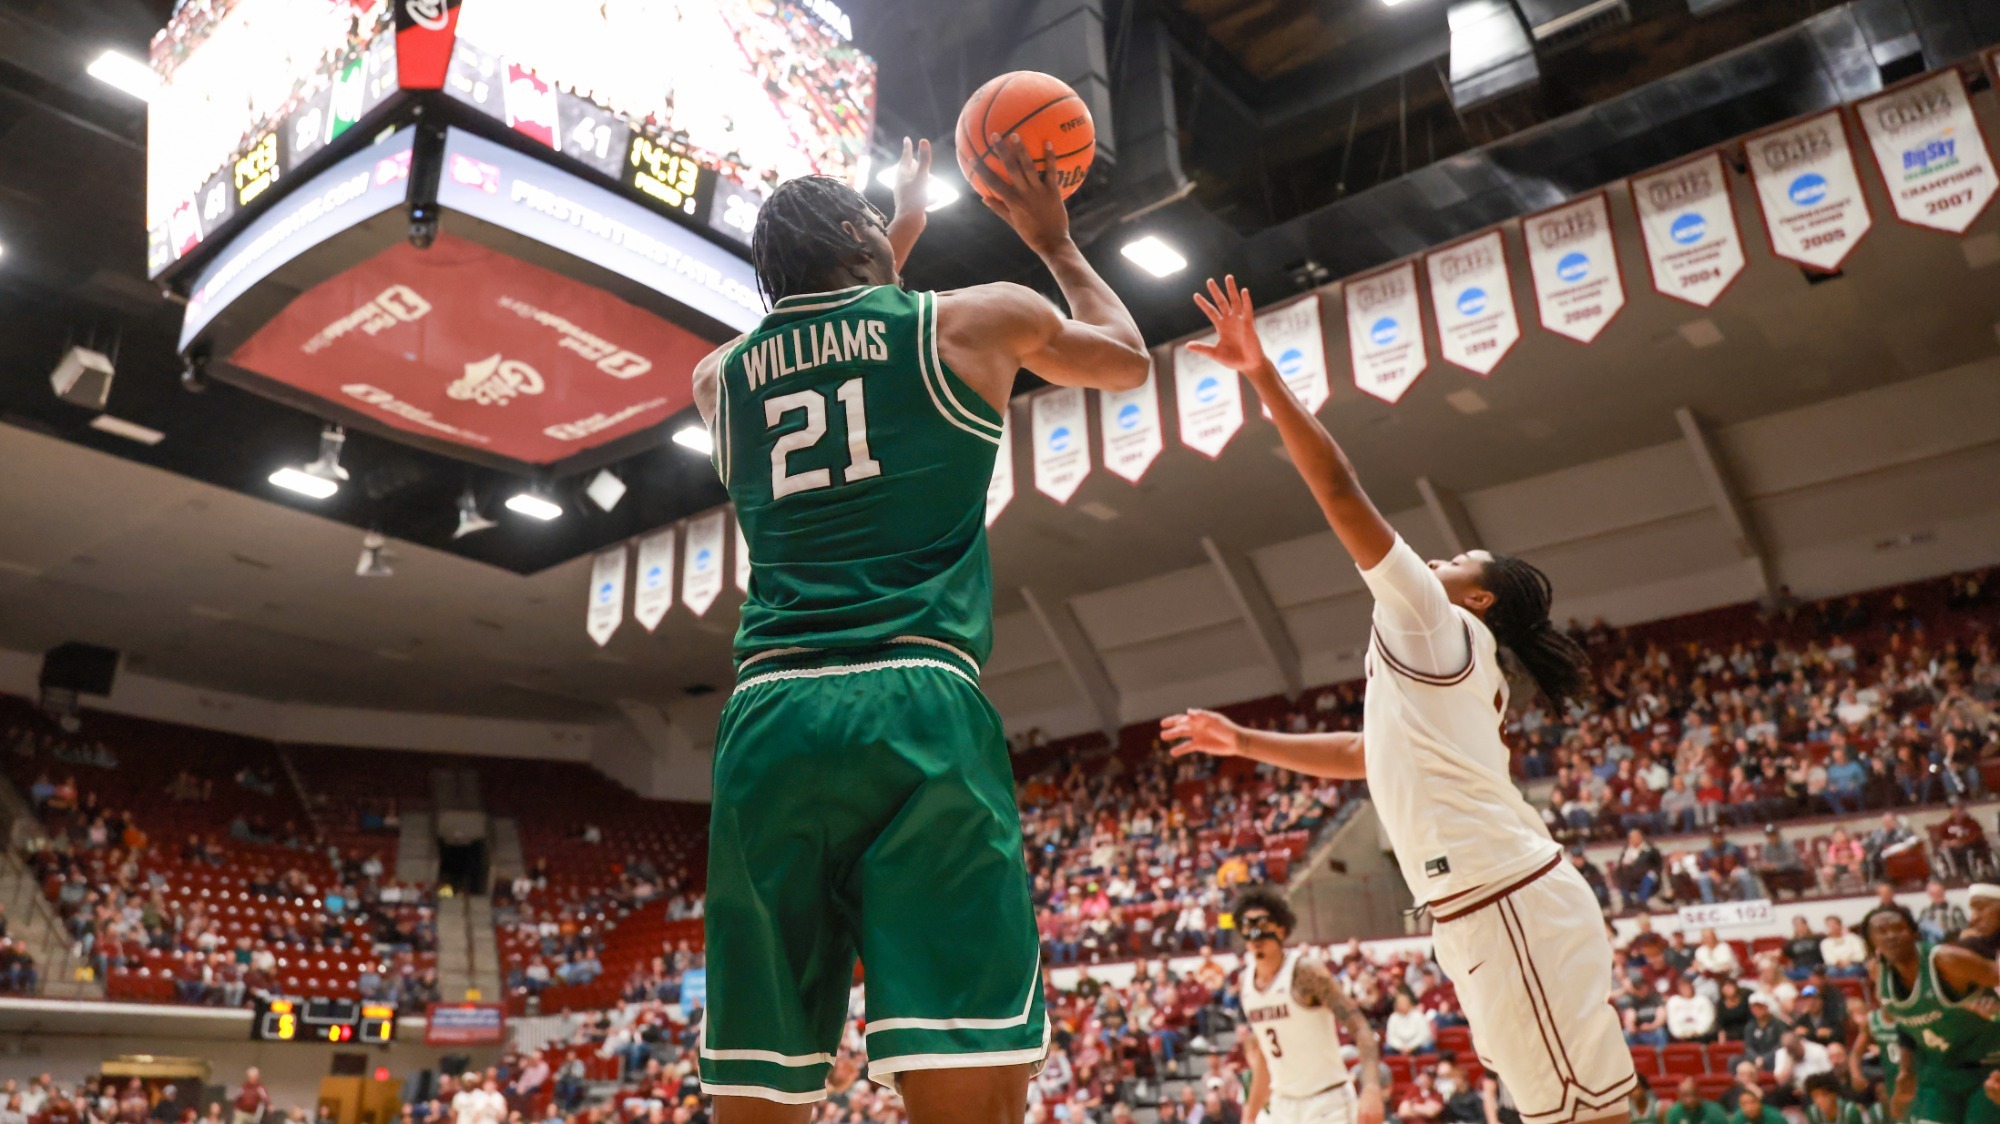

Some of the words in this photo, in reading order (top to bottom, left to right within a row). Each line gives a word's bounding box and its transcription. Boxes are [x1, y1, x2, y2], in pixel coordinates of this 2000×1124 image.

[631, 136, 699, 196] 14:13
[1925, 187, 1973, 215] 2007
[742, 319, 889, 392] WILLIAMS
[764, 377, 881, 501] 21
[1735, 906, 1768, 920] 102
[1266, 1028, 1282, 1058] 3
